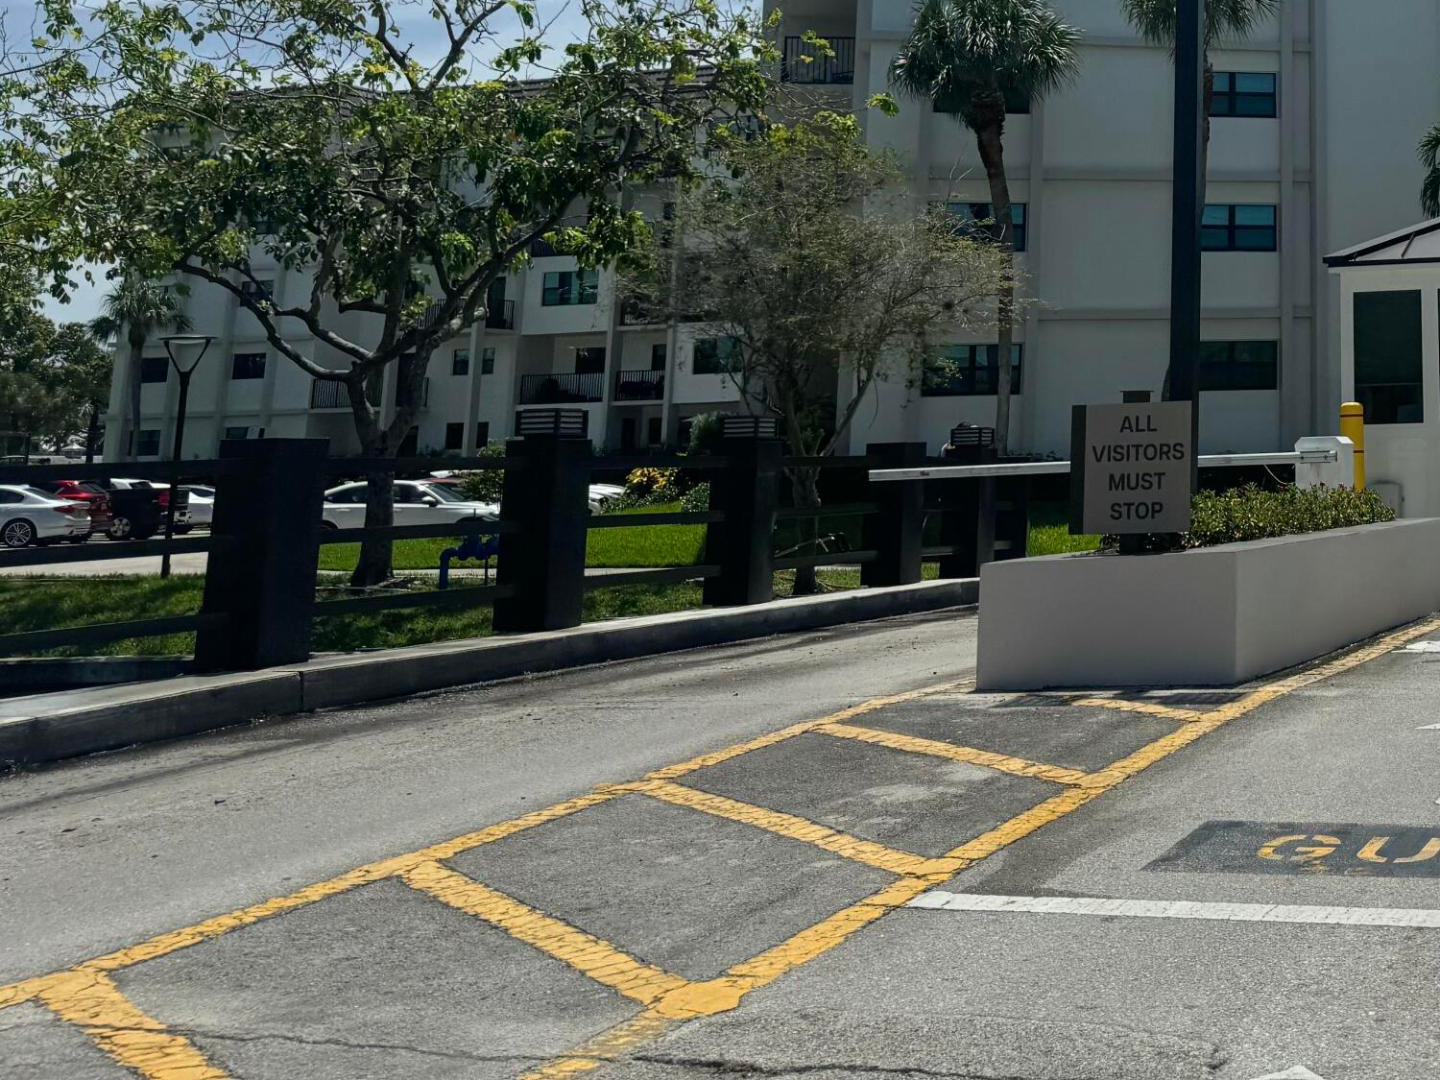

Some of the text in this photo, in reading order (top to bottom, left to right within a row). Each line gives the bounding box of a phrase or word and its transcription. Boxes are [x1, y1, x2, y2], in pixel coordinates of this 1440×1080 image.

[1119, 415, 1158, 433] ALL
[1092, 442, 1185, 463] VISITORS
[1108, 472, 1166, 491] MUST
[1110, 502, 1164, 520] STOP
